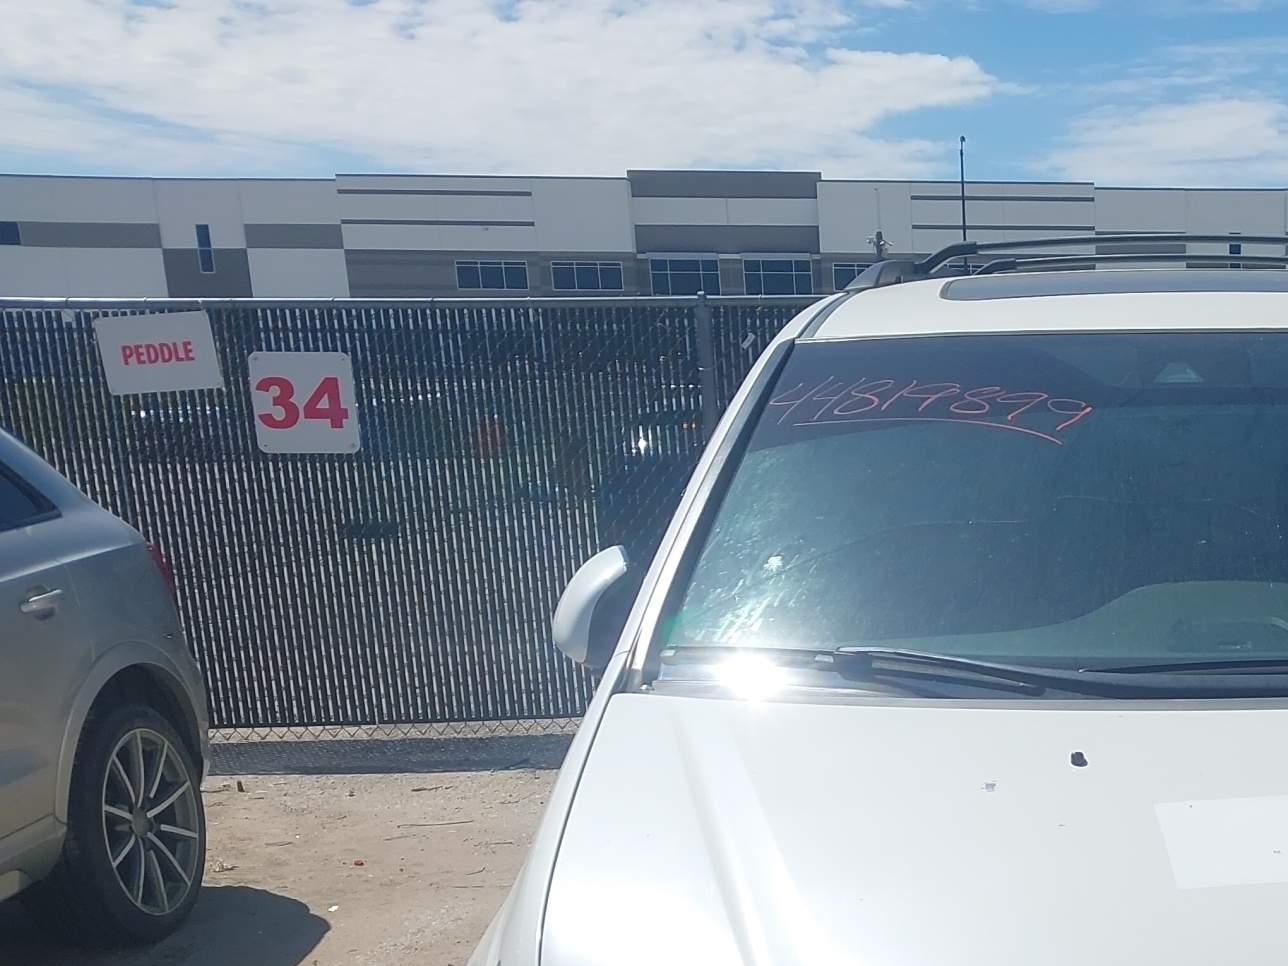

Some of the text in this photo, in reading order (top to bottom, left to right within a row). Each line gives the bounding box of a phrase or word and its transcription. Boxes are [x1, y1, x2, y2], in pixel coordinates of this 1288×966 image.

[121, 341, 195, 366] PEDDLE
[255, 376, 348, 429] 34
[769, 376, 1094, 432] 44819899
